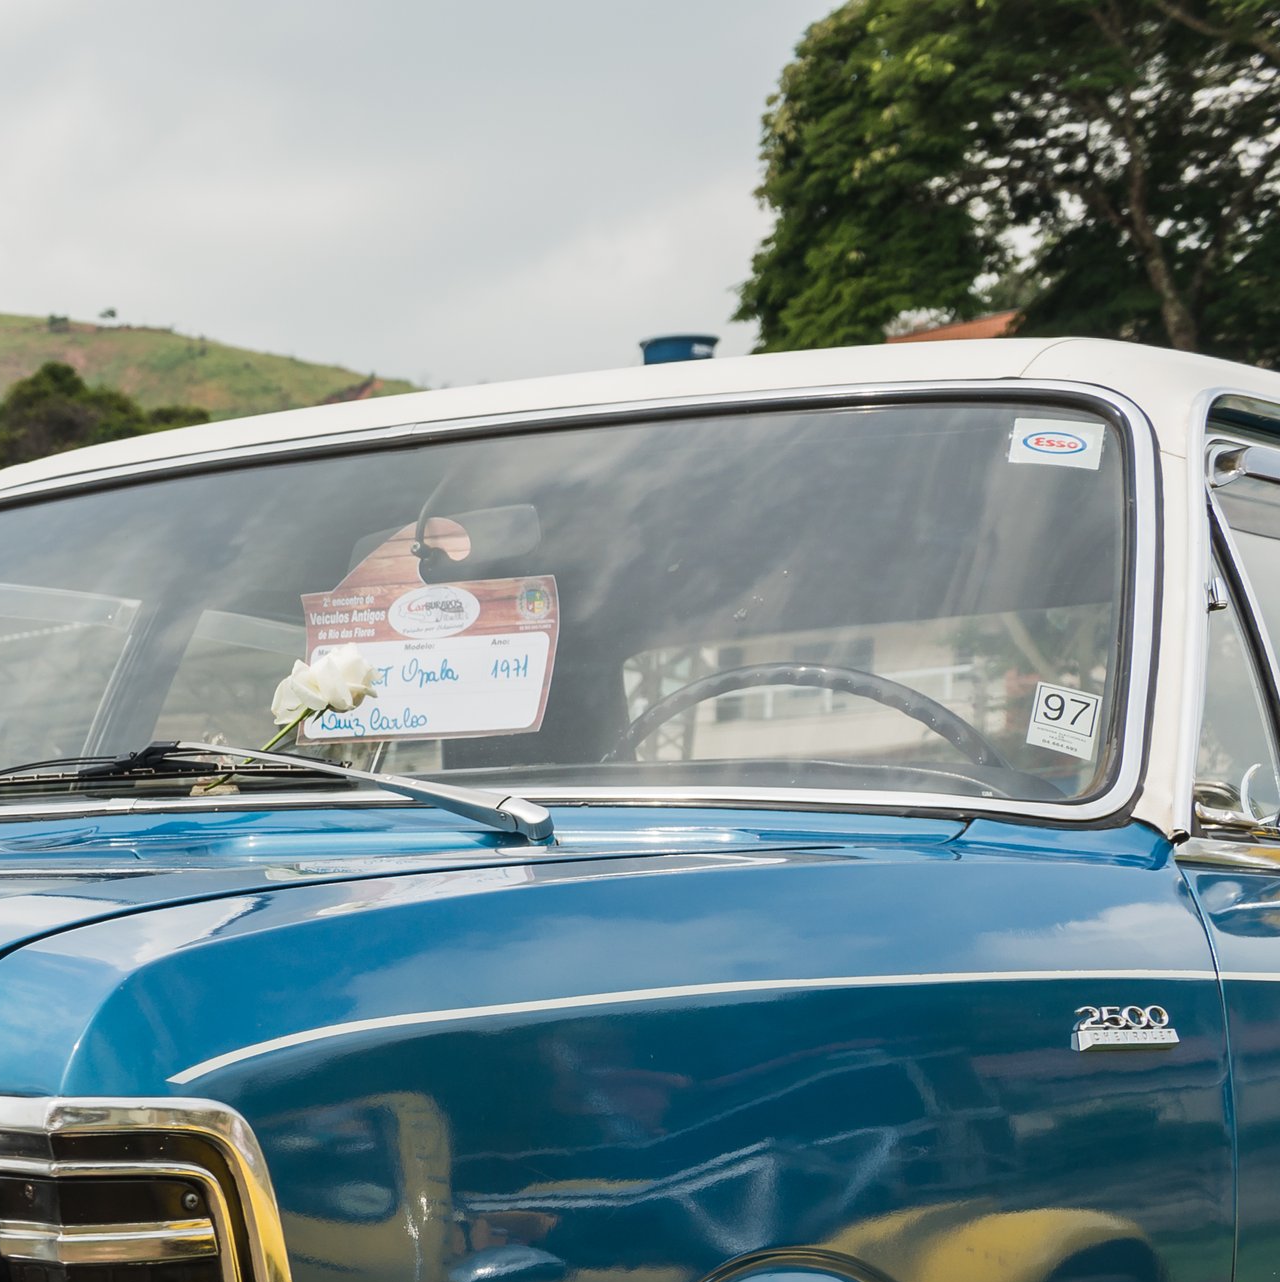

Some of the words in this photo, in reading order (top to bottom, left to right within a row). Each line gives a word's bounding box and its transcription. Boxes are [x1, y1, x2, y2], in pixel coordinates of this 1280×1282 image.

[351, 608, 386, 625] Antigos
[354, 627, 376, 638] Flores
[491, 654, 529, 679] 1971
[369, 707, 428, 731] Carlos
[1043, 693, 1091, 726] 97
[1073, 1005, 1169, 1031] 2500
[1092, 1030, 1173, 1042] CHEVROLET
